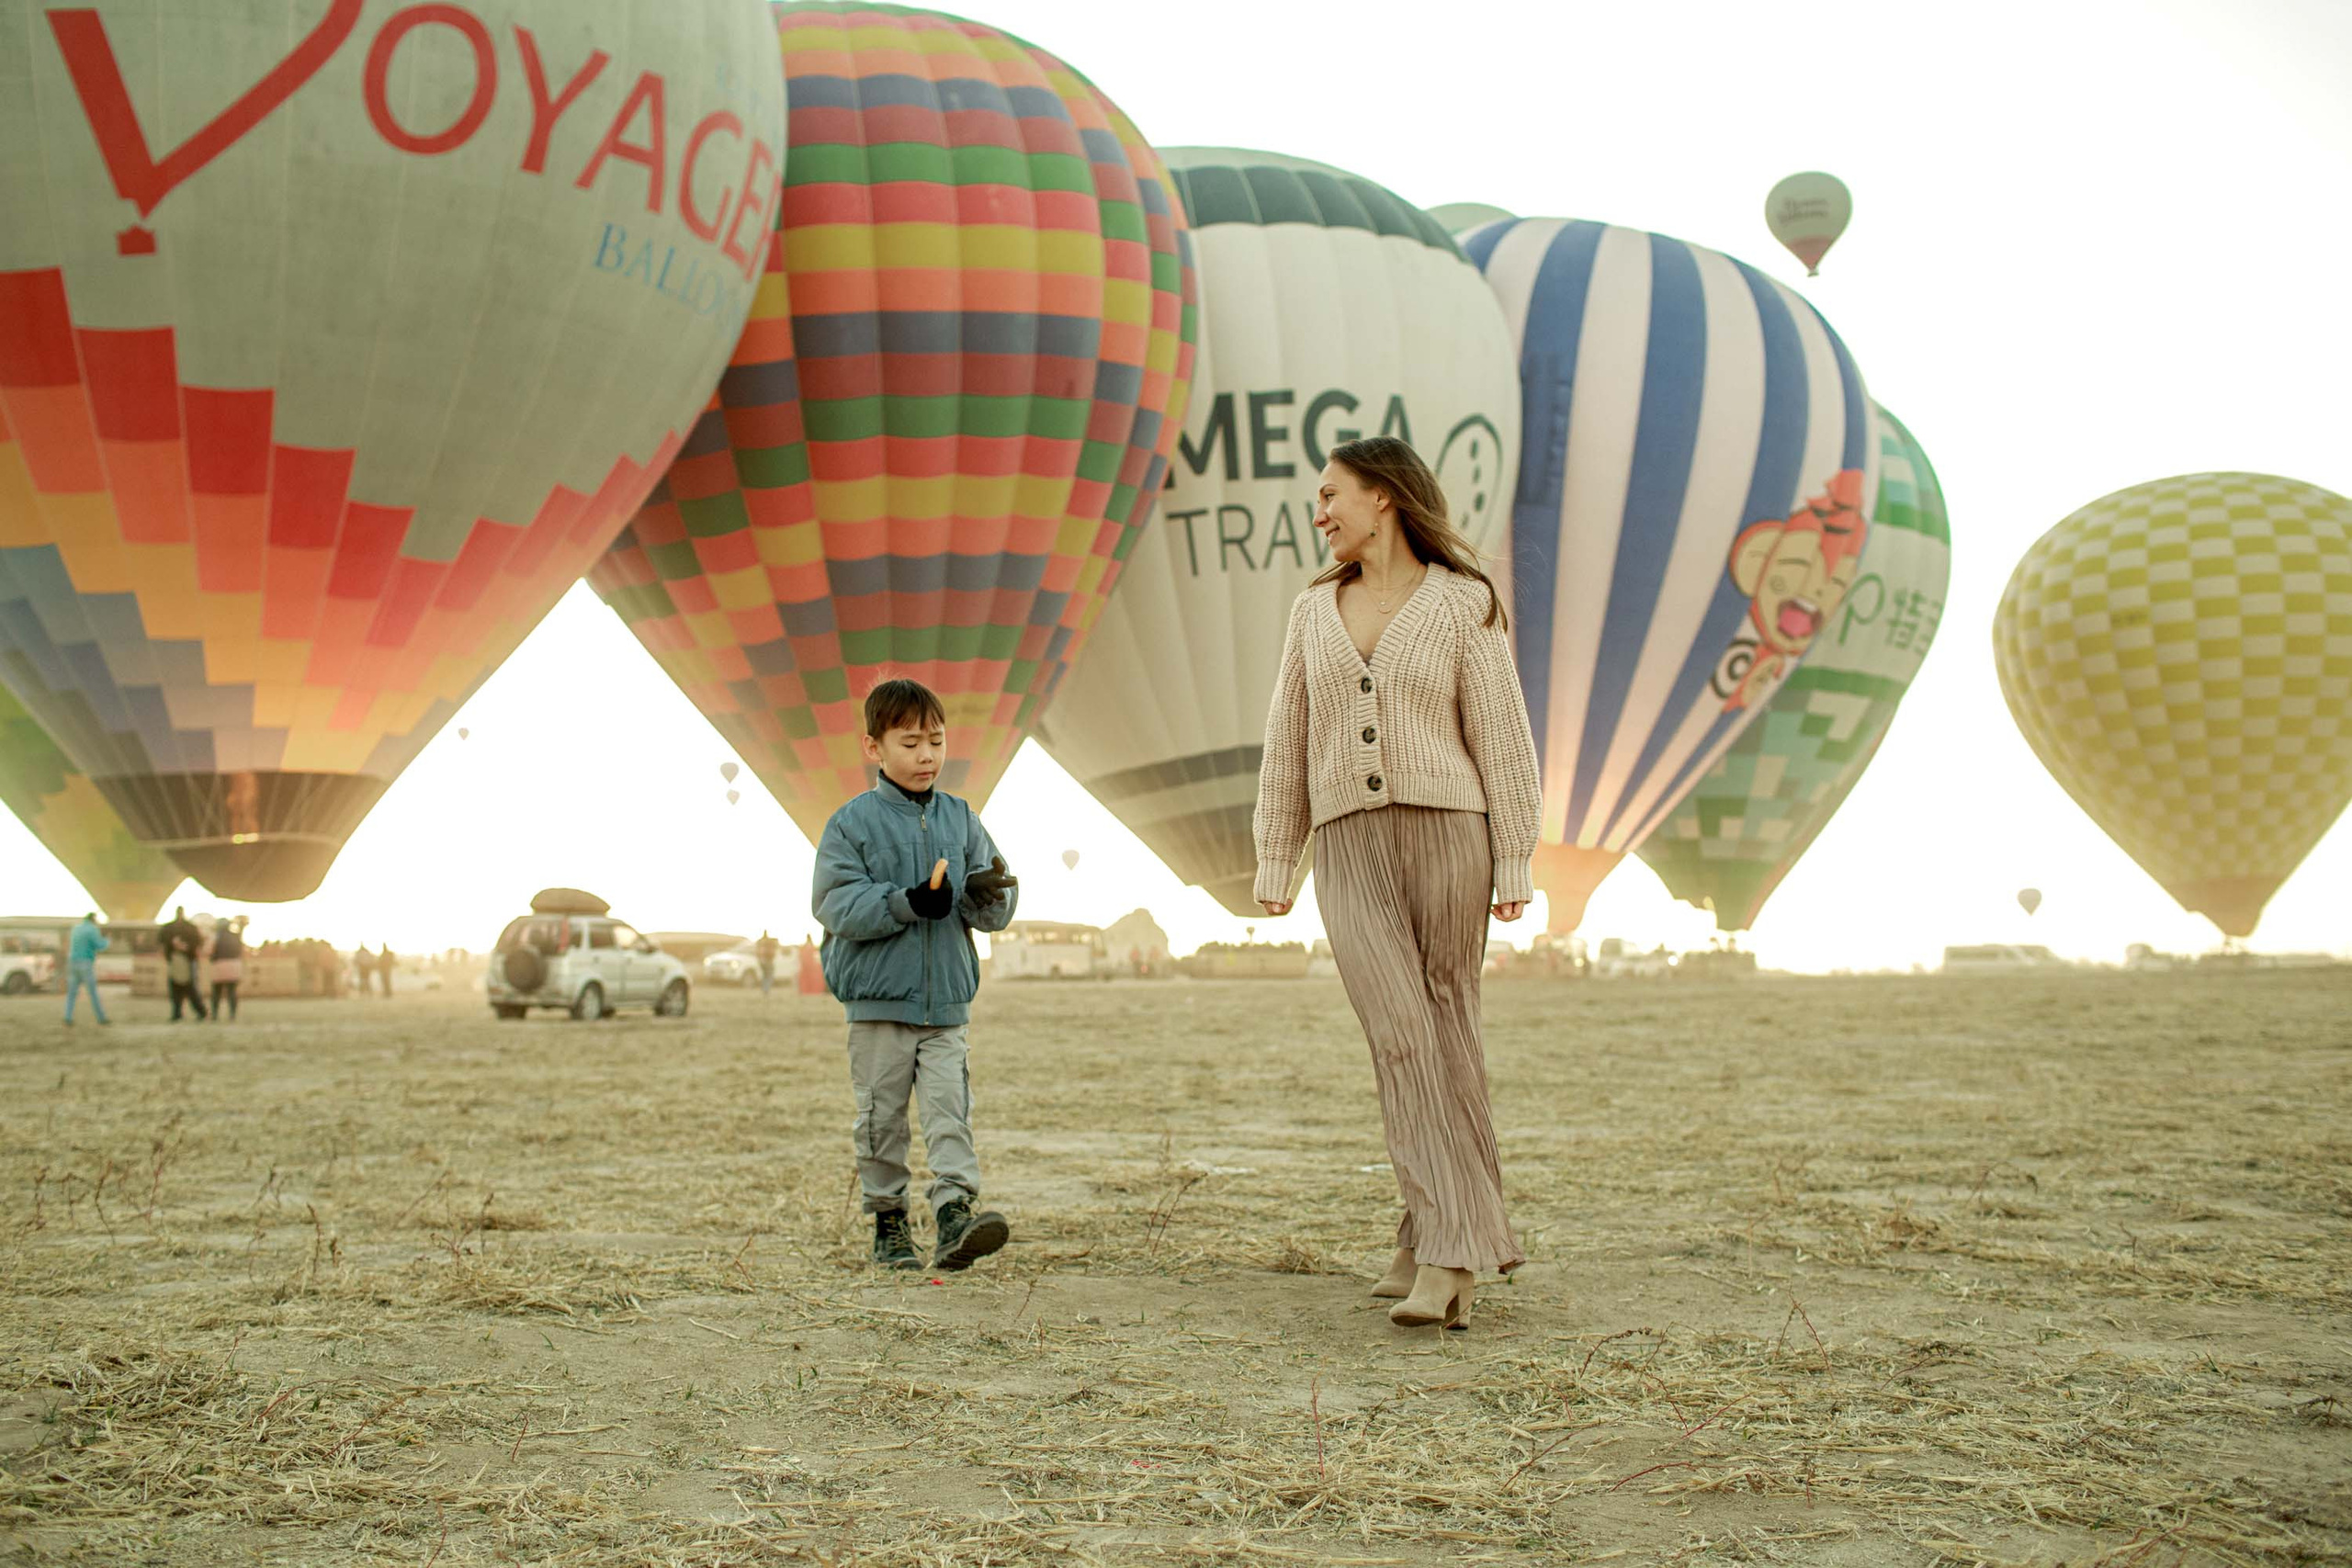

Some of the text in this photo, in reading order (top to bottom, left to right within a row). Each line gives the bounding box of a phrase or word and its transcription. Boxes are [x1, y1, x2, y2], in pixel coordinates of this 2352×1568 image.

[594, 223, 735, 321] BALLO
[1164, 389, 1412, 490] MEGA
[1166, 502, 1330, 577] TRAV
